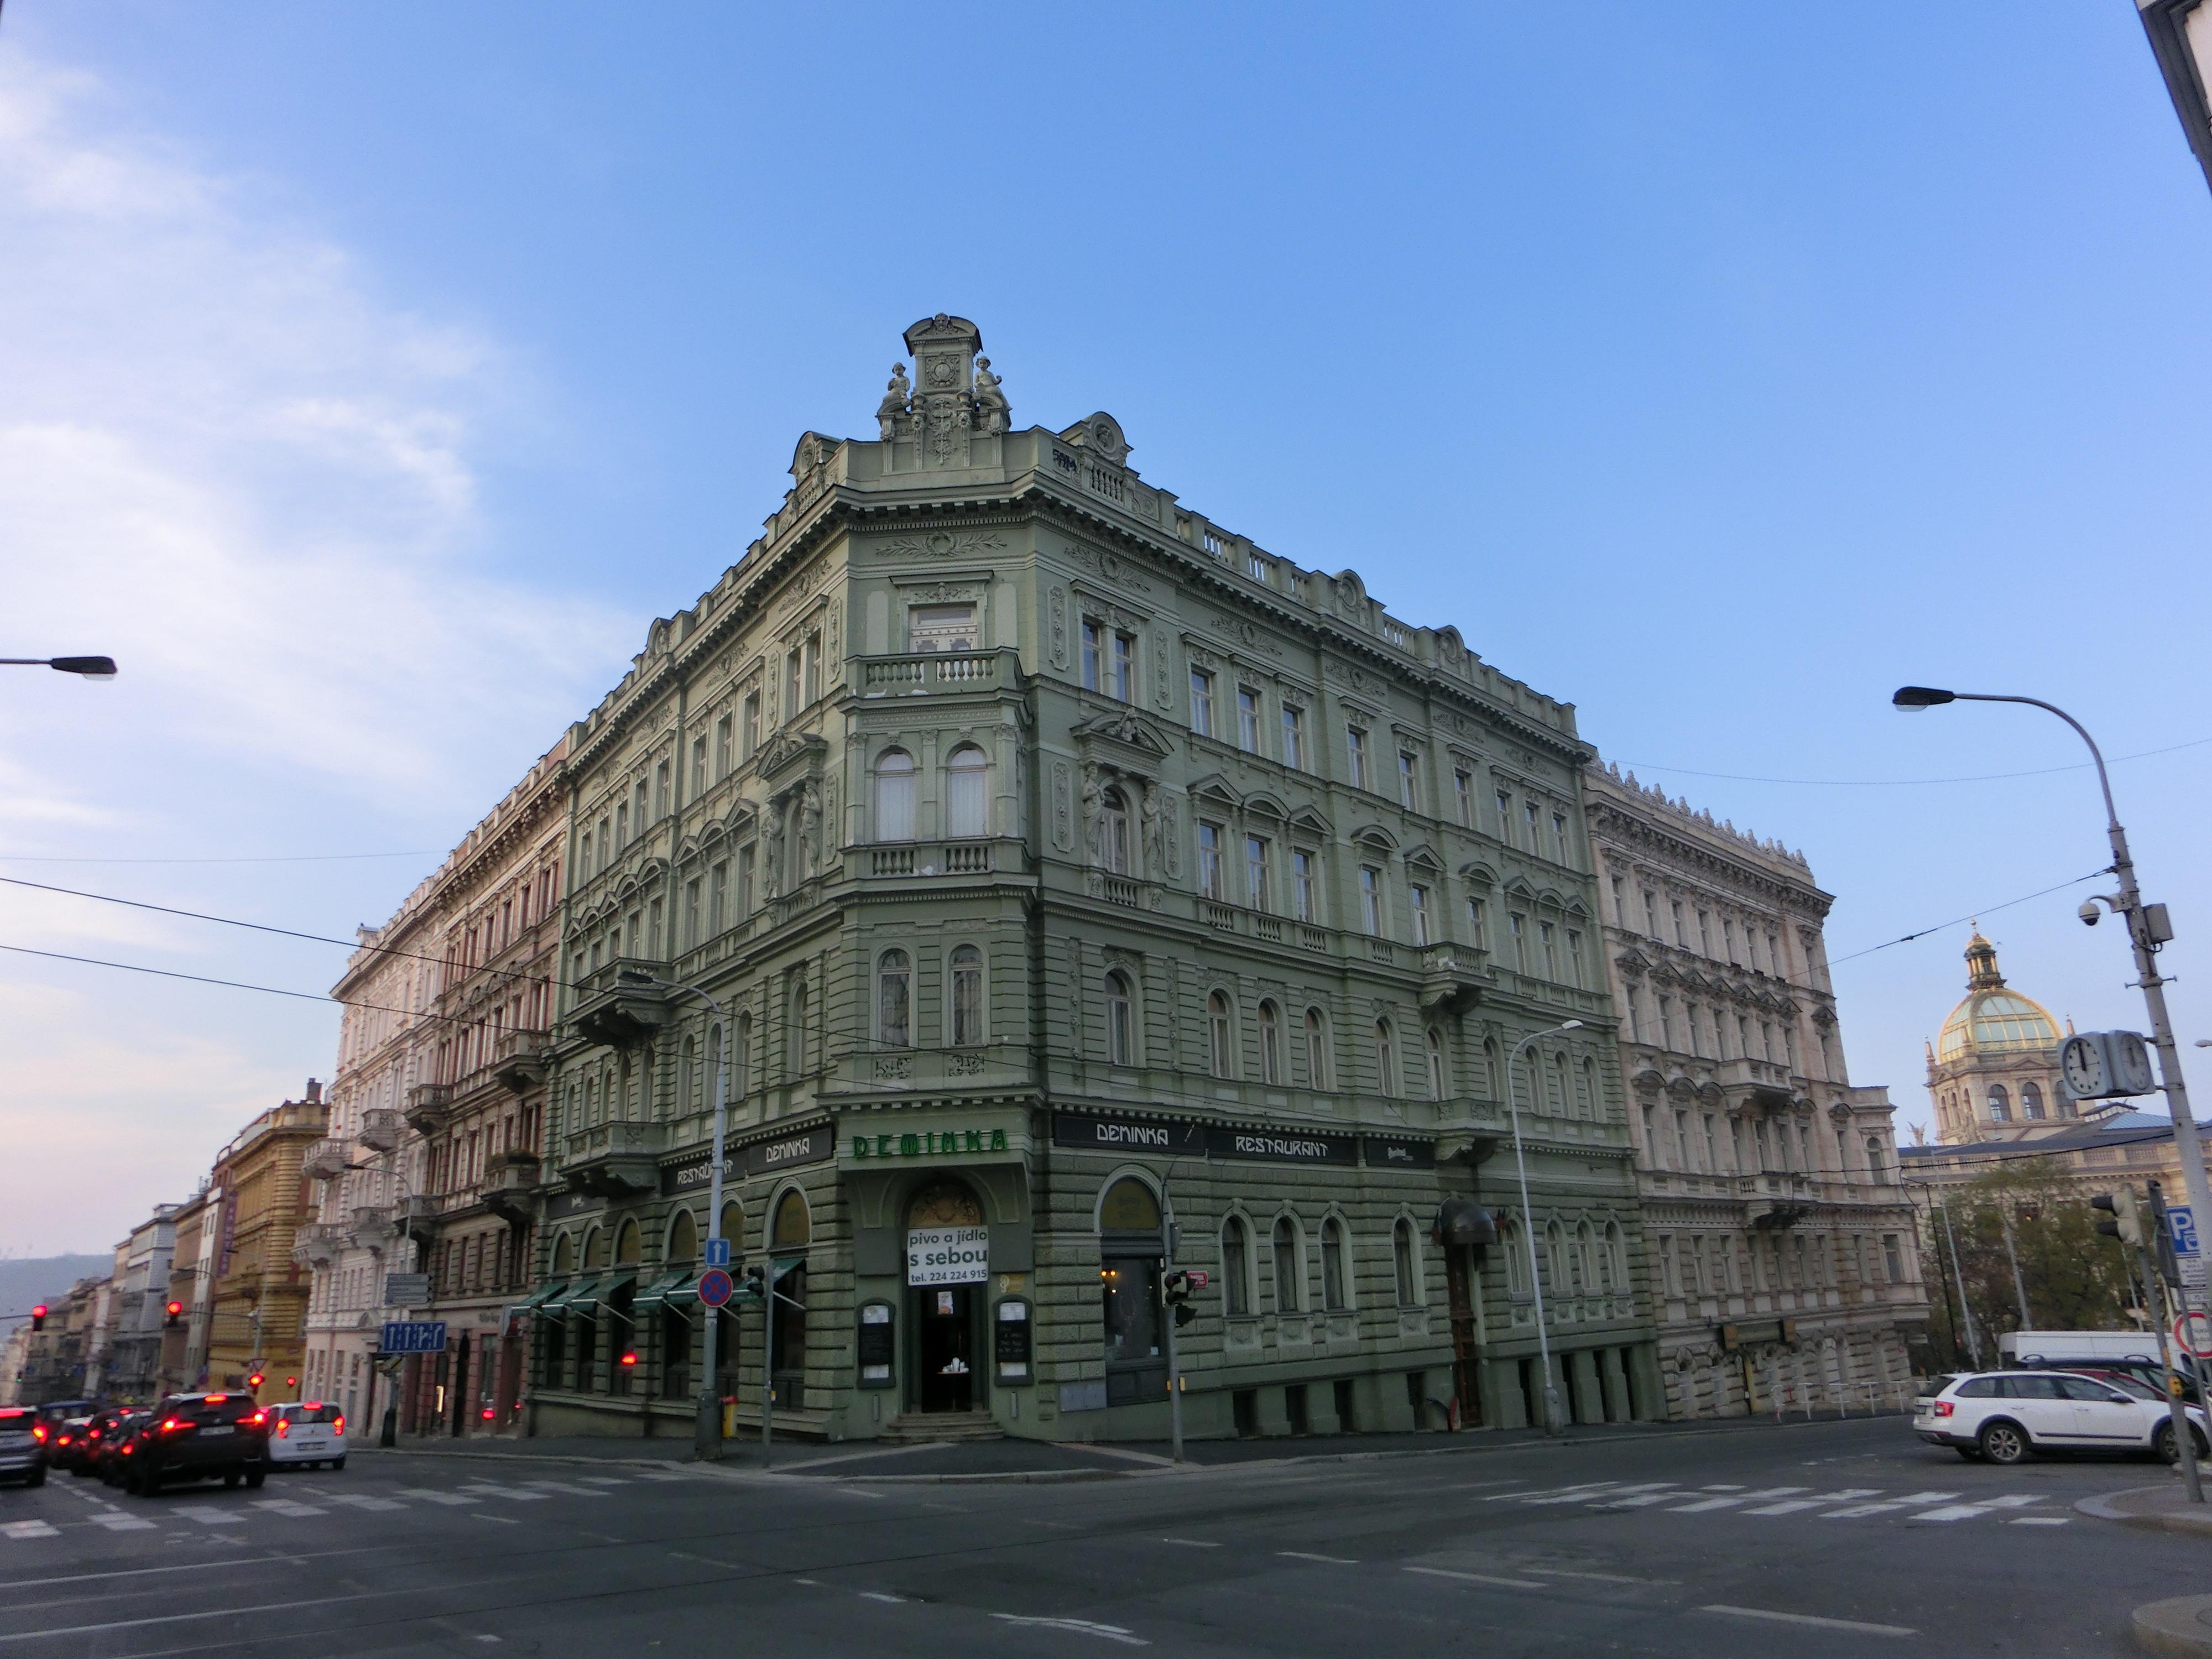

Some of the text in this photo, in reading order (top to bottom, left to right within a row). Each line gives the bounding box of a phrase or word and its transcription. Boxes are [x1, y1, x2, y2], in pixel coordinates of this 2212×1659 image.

[852, 1129, 1006, 1159] DEMINKA
[1097, 1124, 1169, 1145] DEMINKA
[766, 1137, 810, 1162] DEMINKA
[1235, 1136, 1328, 1157] RESTAURANT
[2169, 1212, 2192, 1240] P
[910, 1229, 988, 1248] pivo a jídlo
[910, 1246, 987, 1266] s sebou
[911, 1269, 987, 1282] tel. 224 224 915
